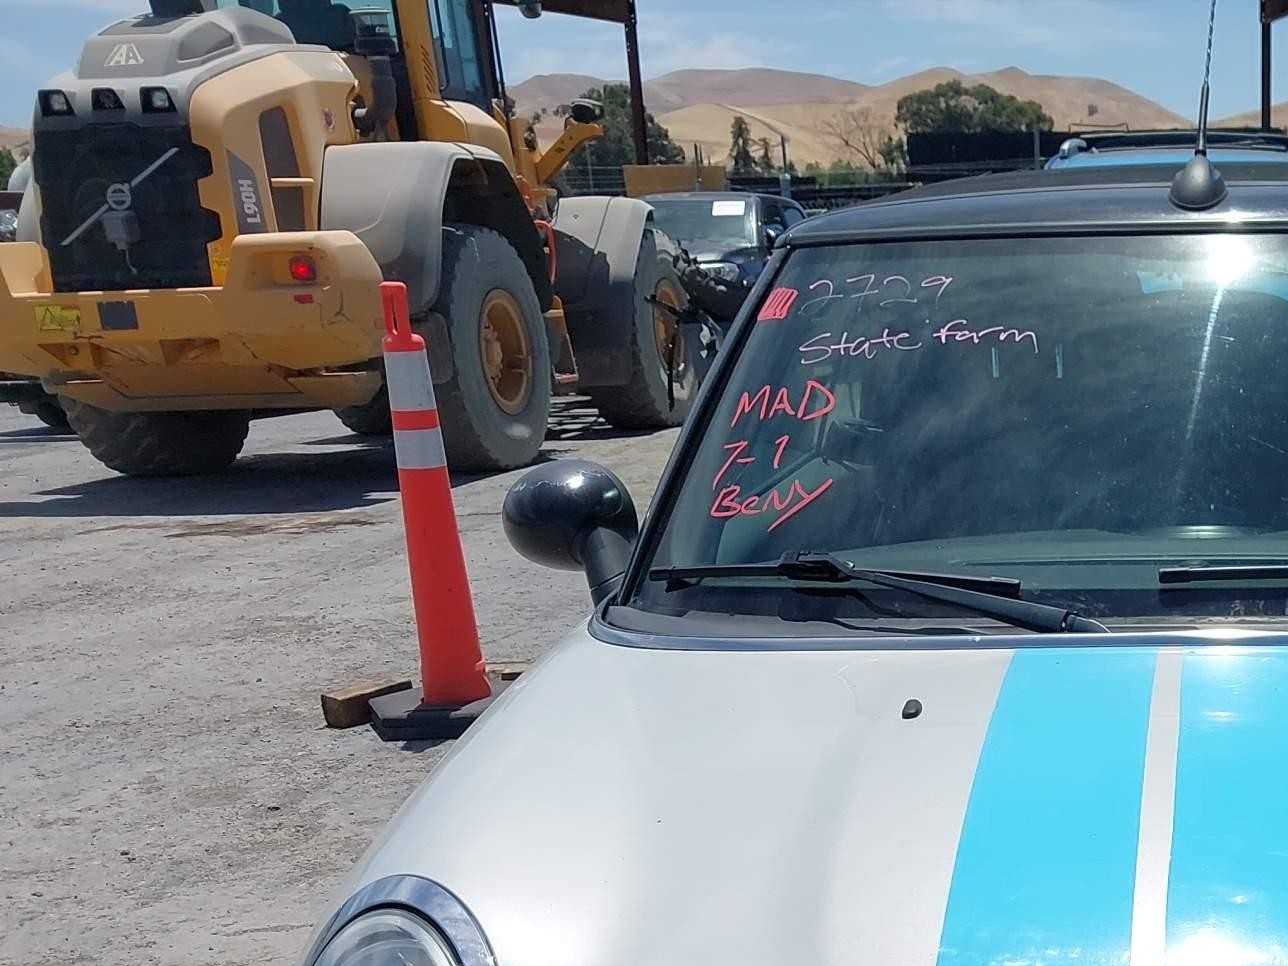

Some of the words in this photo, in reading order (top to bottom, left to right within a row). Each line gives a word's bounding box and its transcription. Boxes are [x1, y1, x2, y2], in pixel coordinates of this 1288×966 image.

[238, 178, 261, 225] L90H
[798, 274, 953, 316] 2729
[799, 327, 922, 365] State
[731, 380, 836, 427] MAD
